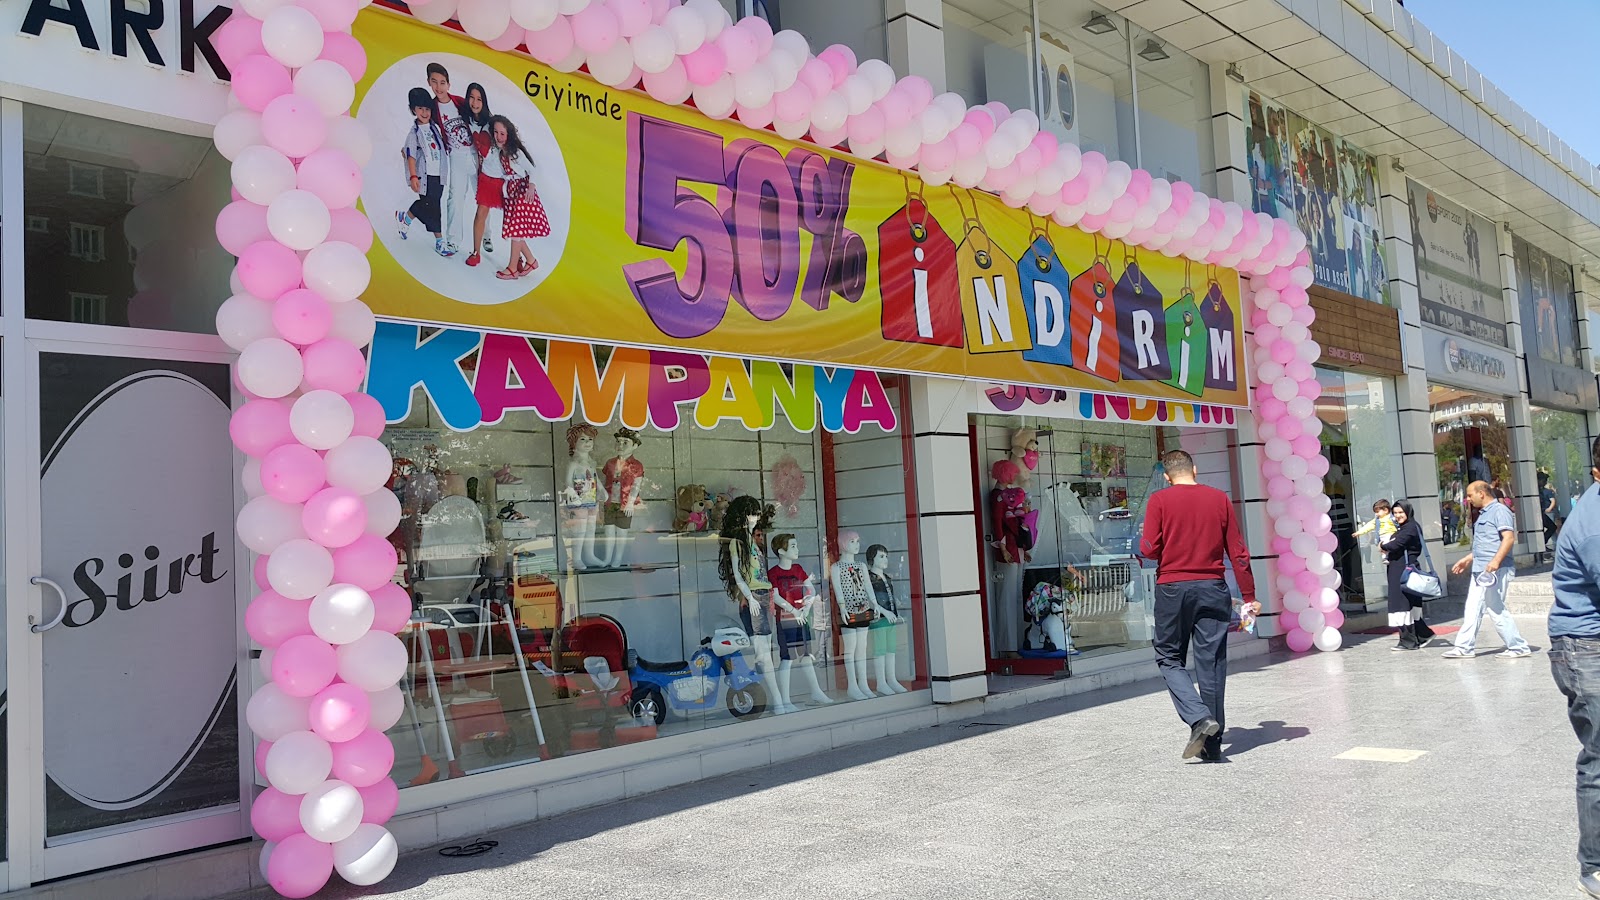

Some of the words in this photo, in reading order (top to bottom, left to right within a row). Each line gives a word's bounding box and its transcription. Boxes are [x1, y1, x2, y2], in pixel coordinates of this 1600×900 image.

[524, 70, 622, 120] Giyimde
[622, 111, 868, 339] 50%
[1314, 263, 1331, 282] POLO
[364, 321, 897, 433] KAMPANYA
[61, 531, 228, 628] Siirt
